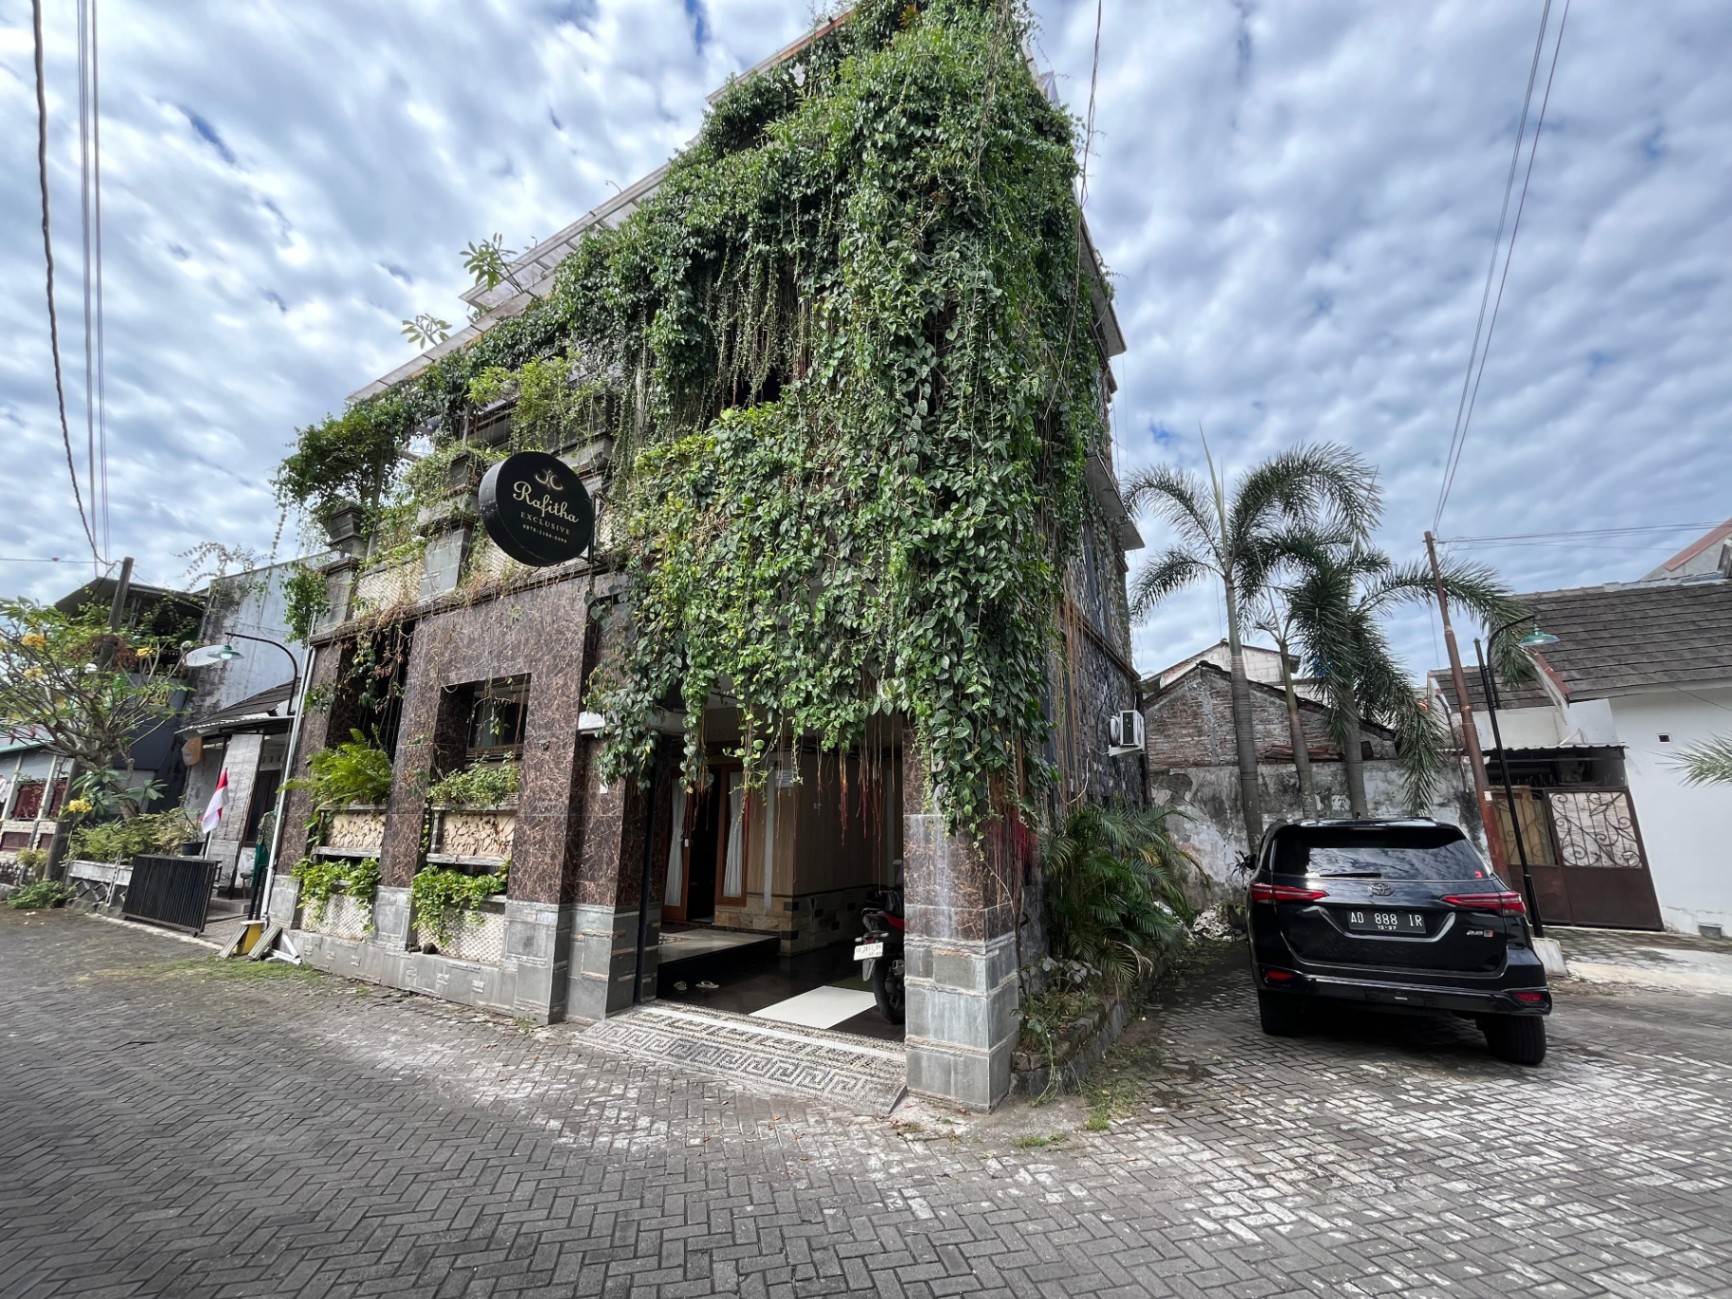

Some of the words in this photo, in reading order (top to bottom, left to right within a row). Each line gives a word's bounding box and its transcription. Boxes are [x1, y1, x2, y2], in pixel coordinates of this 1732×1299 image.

[512, 481, 579, 523] Rafitha
[520, 511, 570, 535] EXCLUSIVE
[1350, 911, 1364, 924] AD
[1374, 912, 1398, 925] 888
